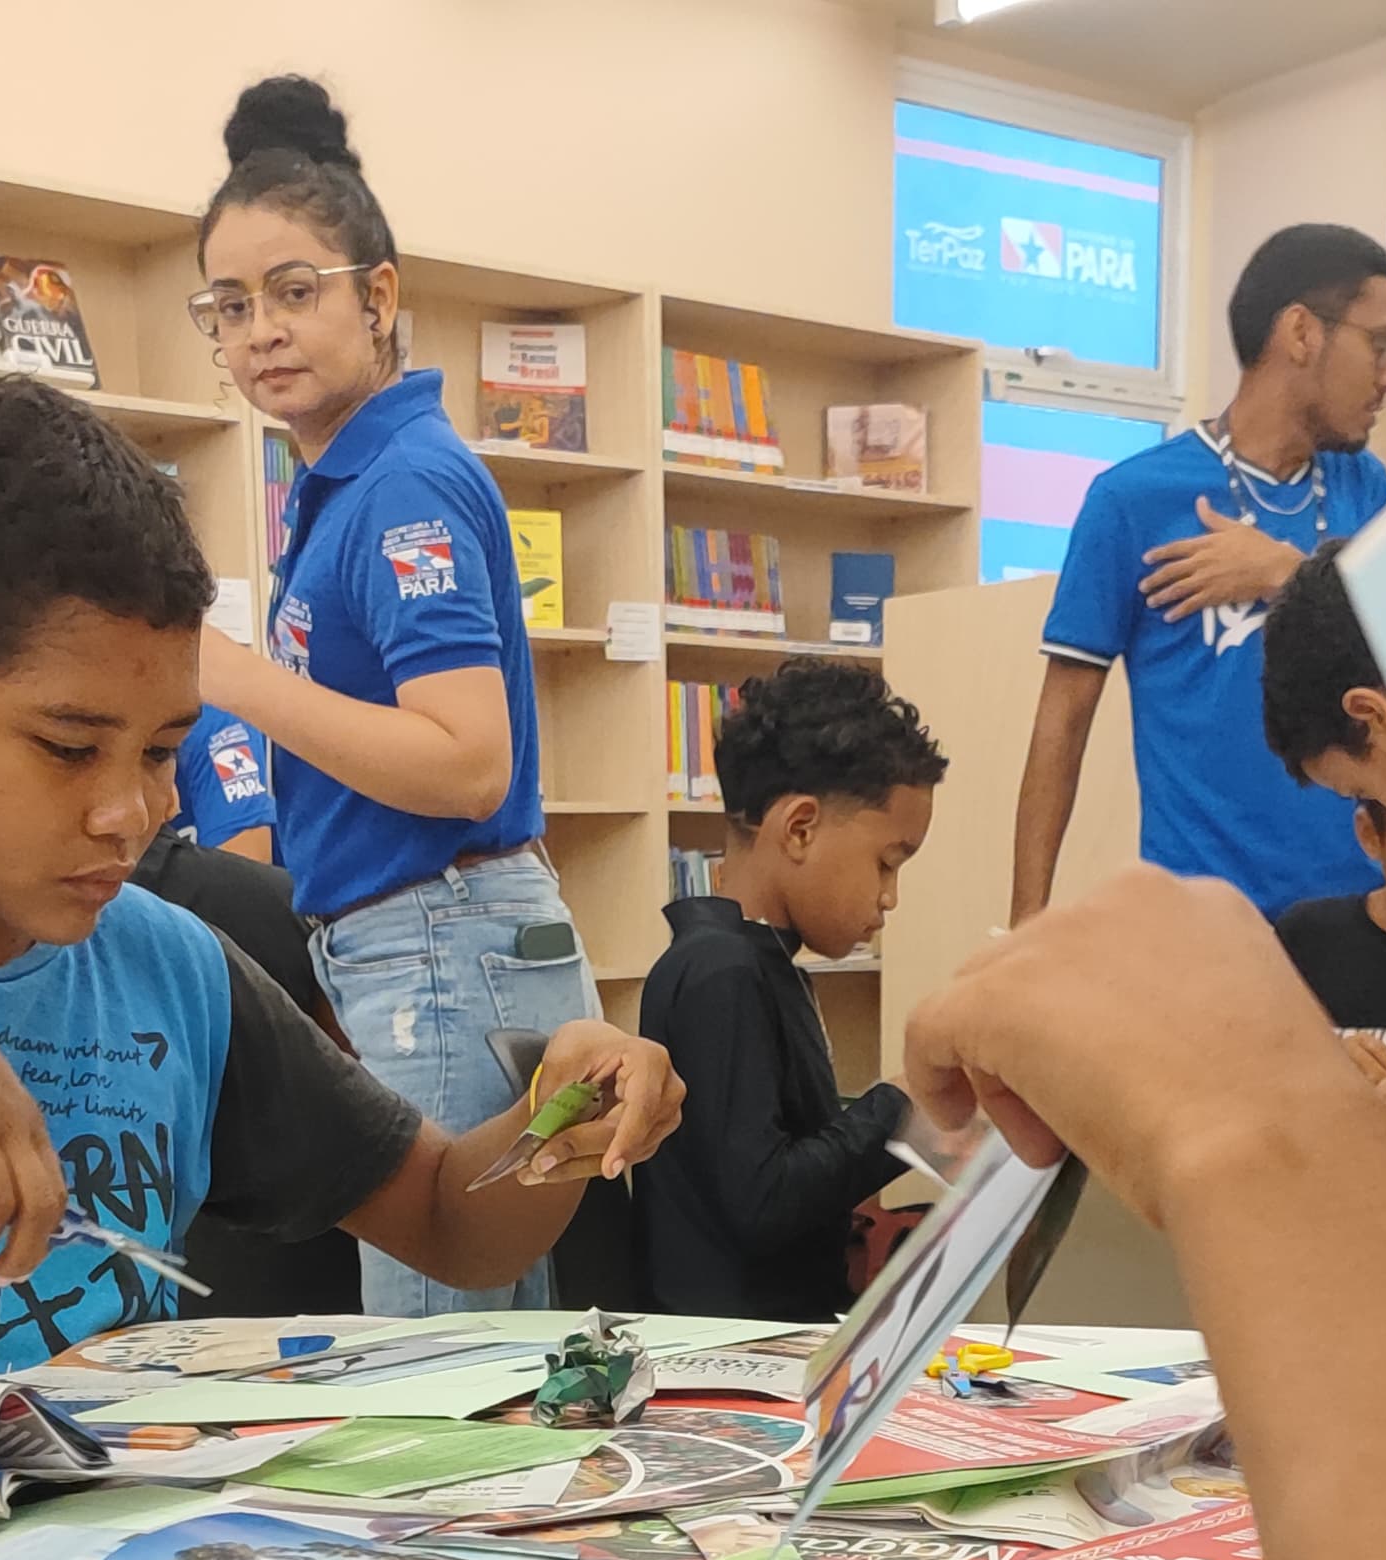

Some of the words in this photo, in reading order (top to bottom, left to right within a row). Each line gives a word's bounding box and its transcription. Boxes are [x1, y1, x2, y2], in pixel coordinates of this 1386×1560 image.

[905, 229, 985, 272] TerPaz
[3, 317, 75, 338] GUERRA
[12, 335, 94, 367] CIVIL
[63, 1037, 144, 1066] witout
